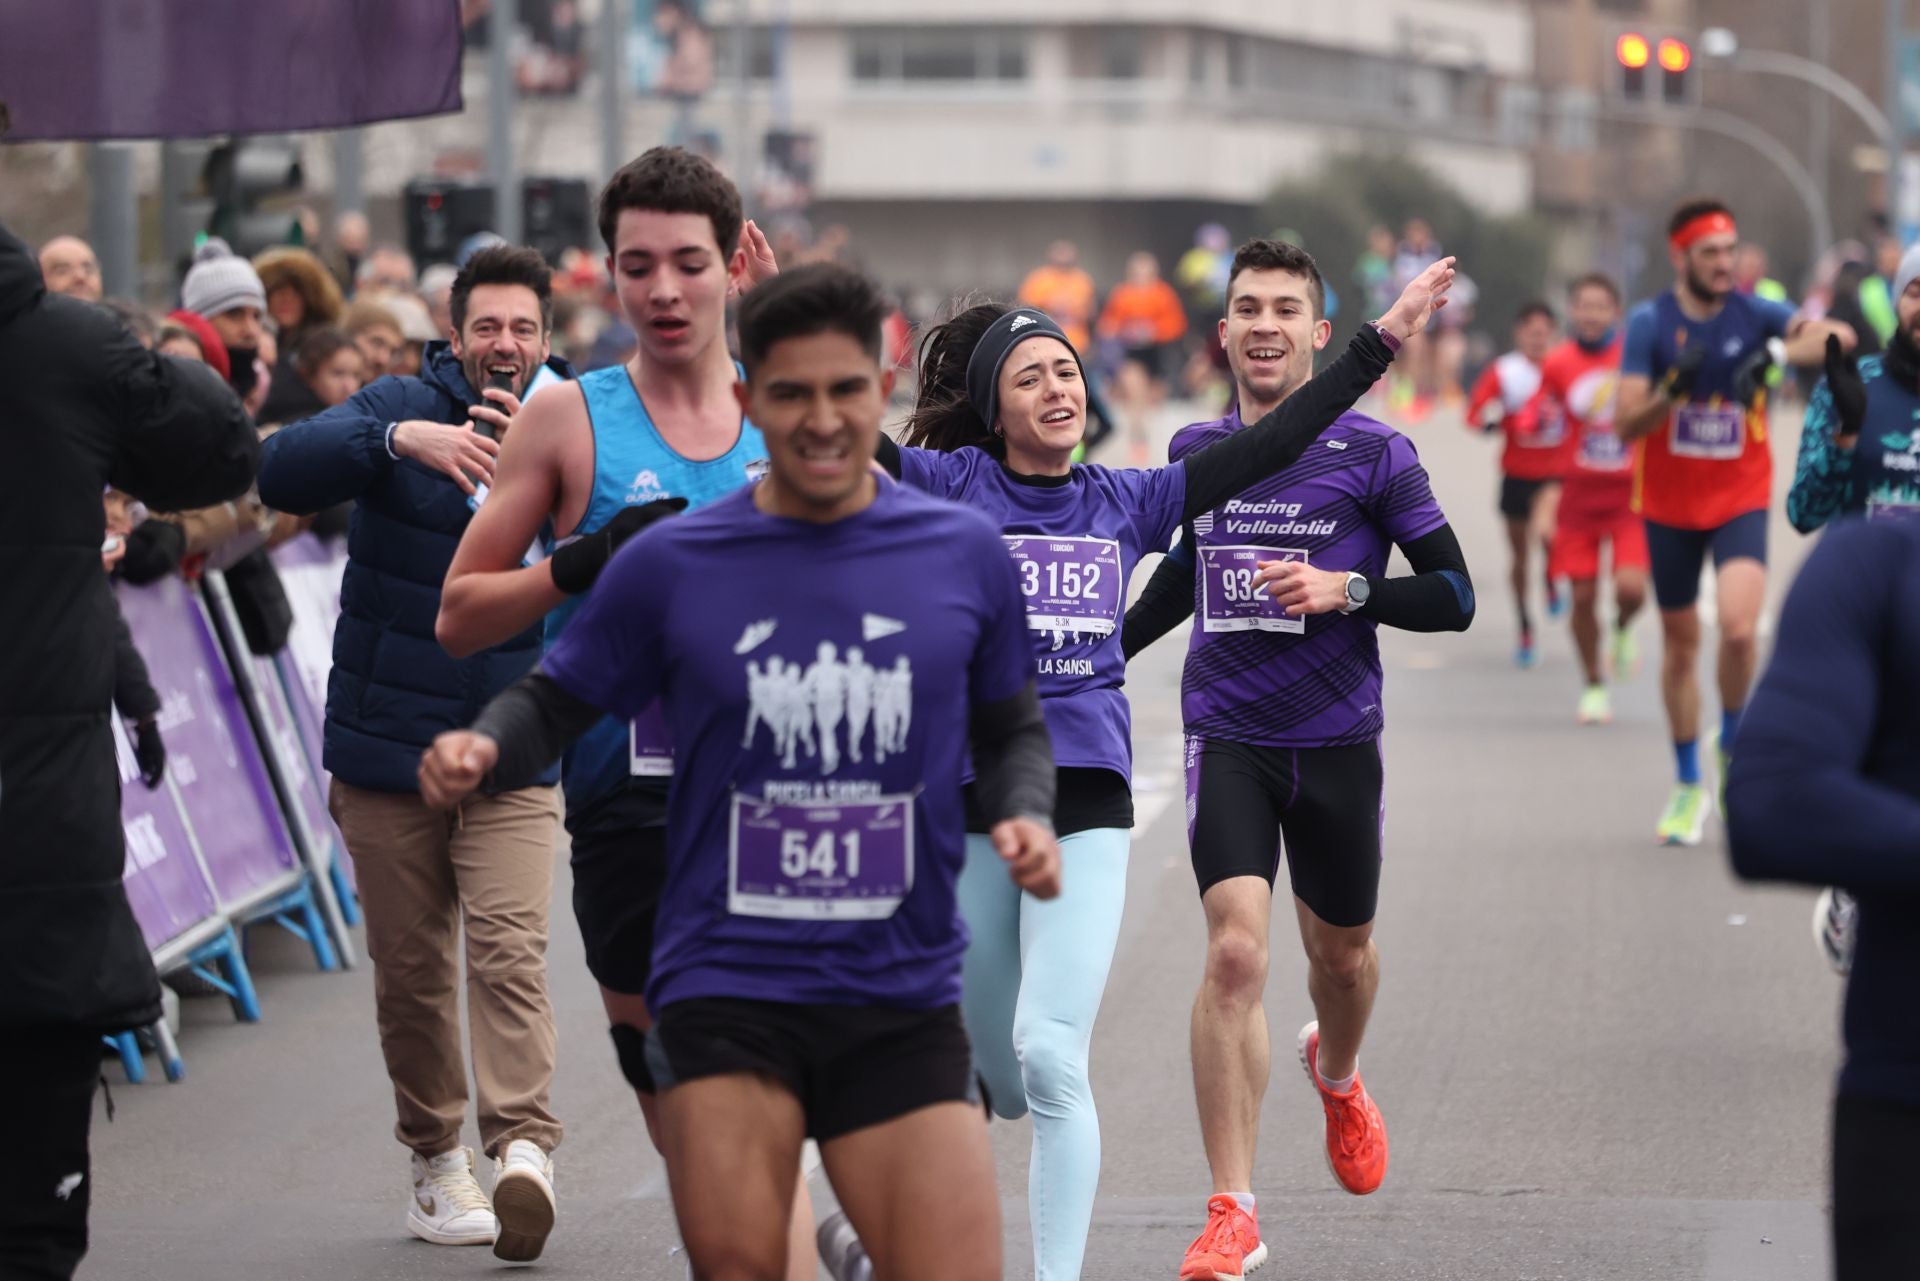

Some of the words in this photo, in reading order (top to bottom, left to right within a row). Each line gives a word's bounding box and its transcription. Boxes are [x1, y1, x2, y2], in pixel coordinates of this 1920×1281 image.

[1224, 499, 1302, 517] Racing
[1226, 520, 1337, 535] Valladolid
[1020, 560, 1101, 599] 3152
[1222, 568, 1270, 602] 932
[1055, 617, 1070, 627] 5.3K
[1056, 659, 1095, 675] SANSIL
[780, 828, 861, 879] 541
